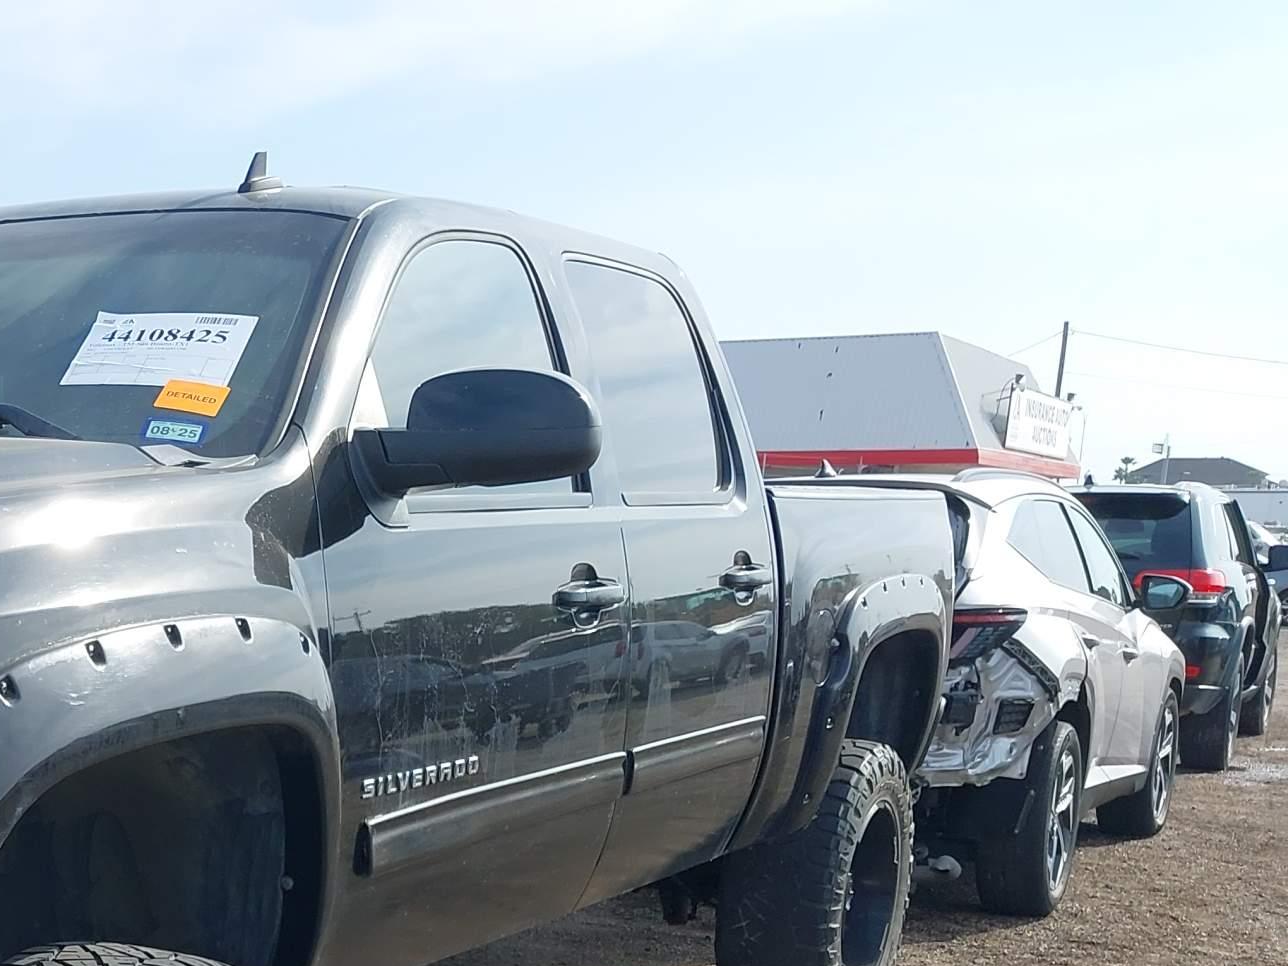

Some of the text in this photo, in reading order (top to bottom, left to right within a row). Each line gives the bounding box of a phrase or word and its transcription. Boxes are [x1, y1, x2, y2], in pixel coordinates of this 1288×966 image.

[101, 328, 230, 344] 44108425
[166, 391, 217, 404] DETAILED
[1024, 398, 1055, 424] INSURANCE
[150, 425, 199, 438] 08 25
[361, 755, 480, 800] SILVERADO
